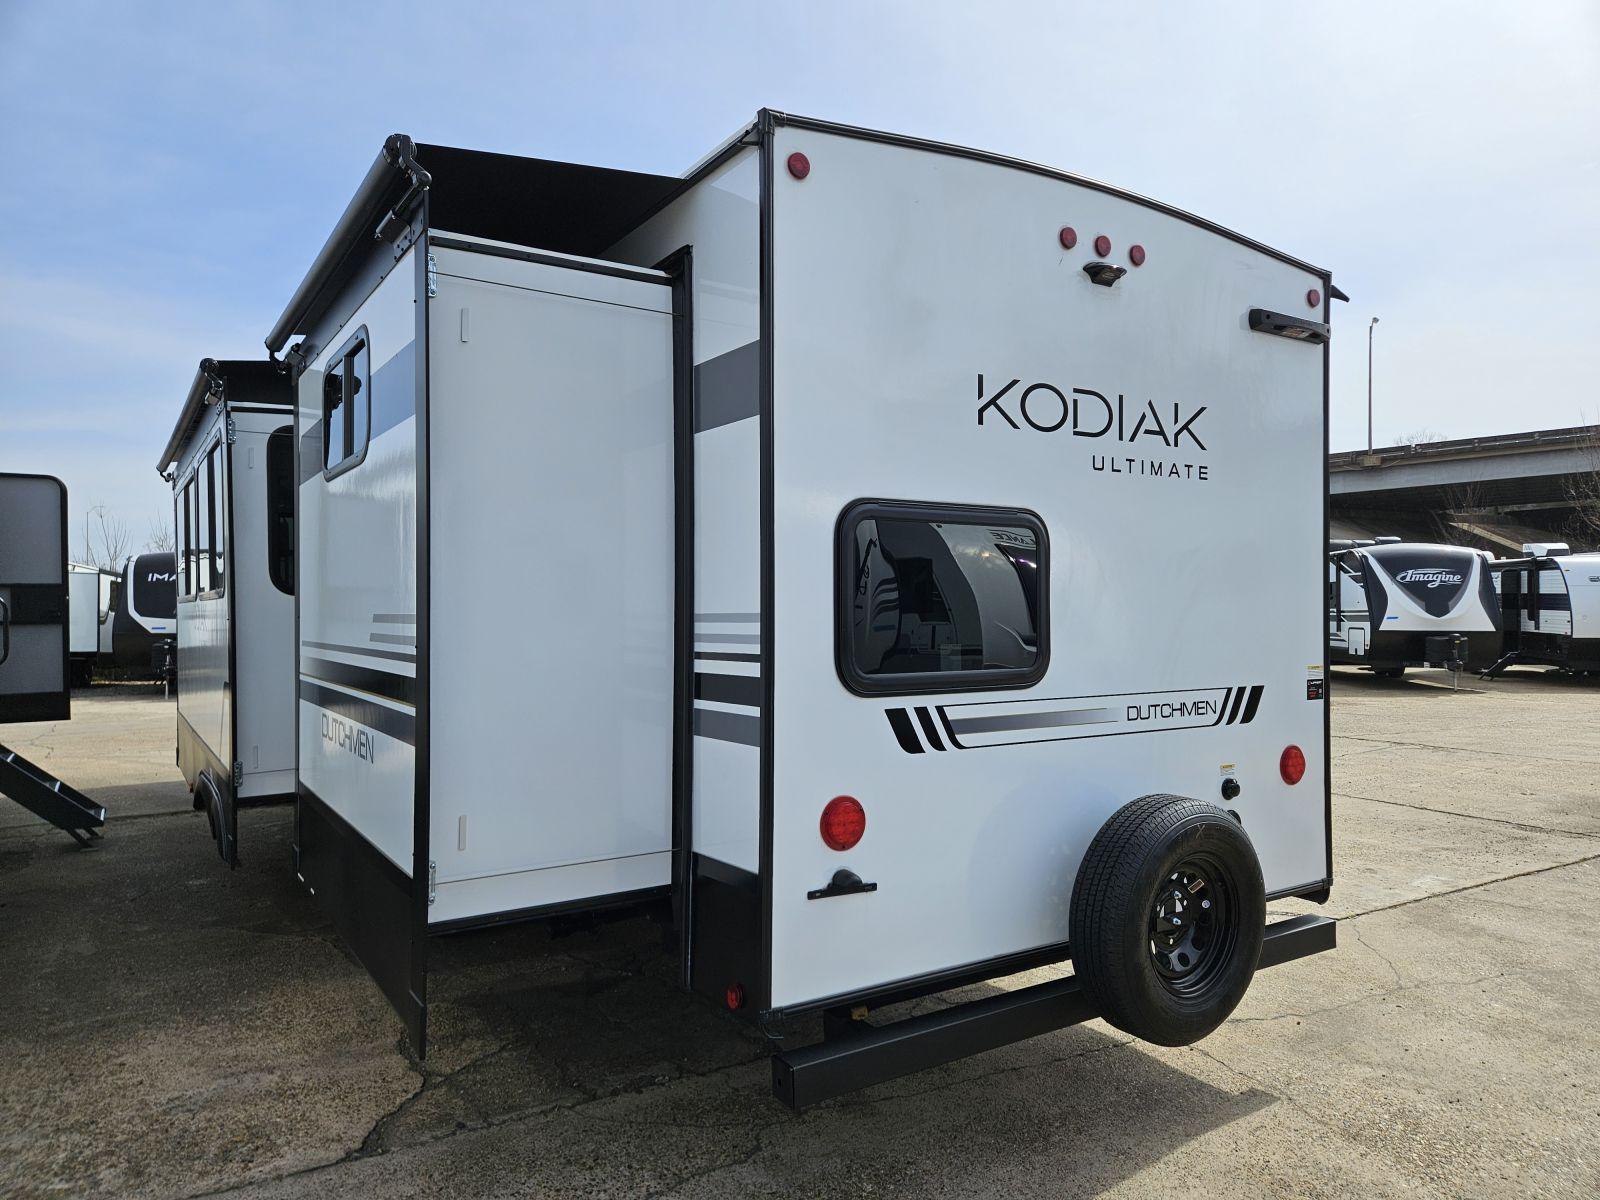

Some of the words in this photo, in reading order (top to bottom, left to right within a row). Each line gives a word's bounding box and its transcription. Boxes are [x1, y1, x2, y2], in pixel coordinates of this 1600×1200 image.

[977, 373, 1208, 451] KODIAK
[1092, 454, 1209, 481] ULTIMATE
[1396, 568, 1463, 588] Imagine
[1127, 700, 1217, 722] DUTCHMEN
[321, 712, 375, 764] DUTCHMEN
